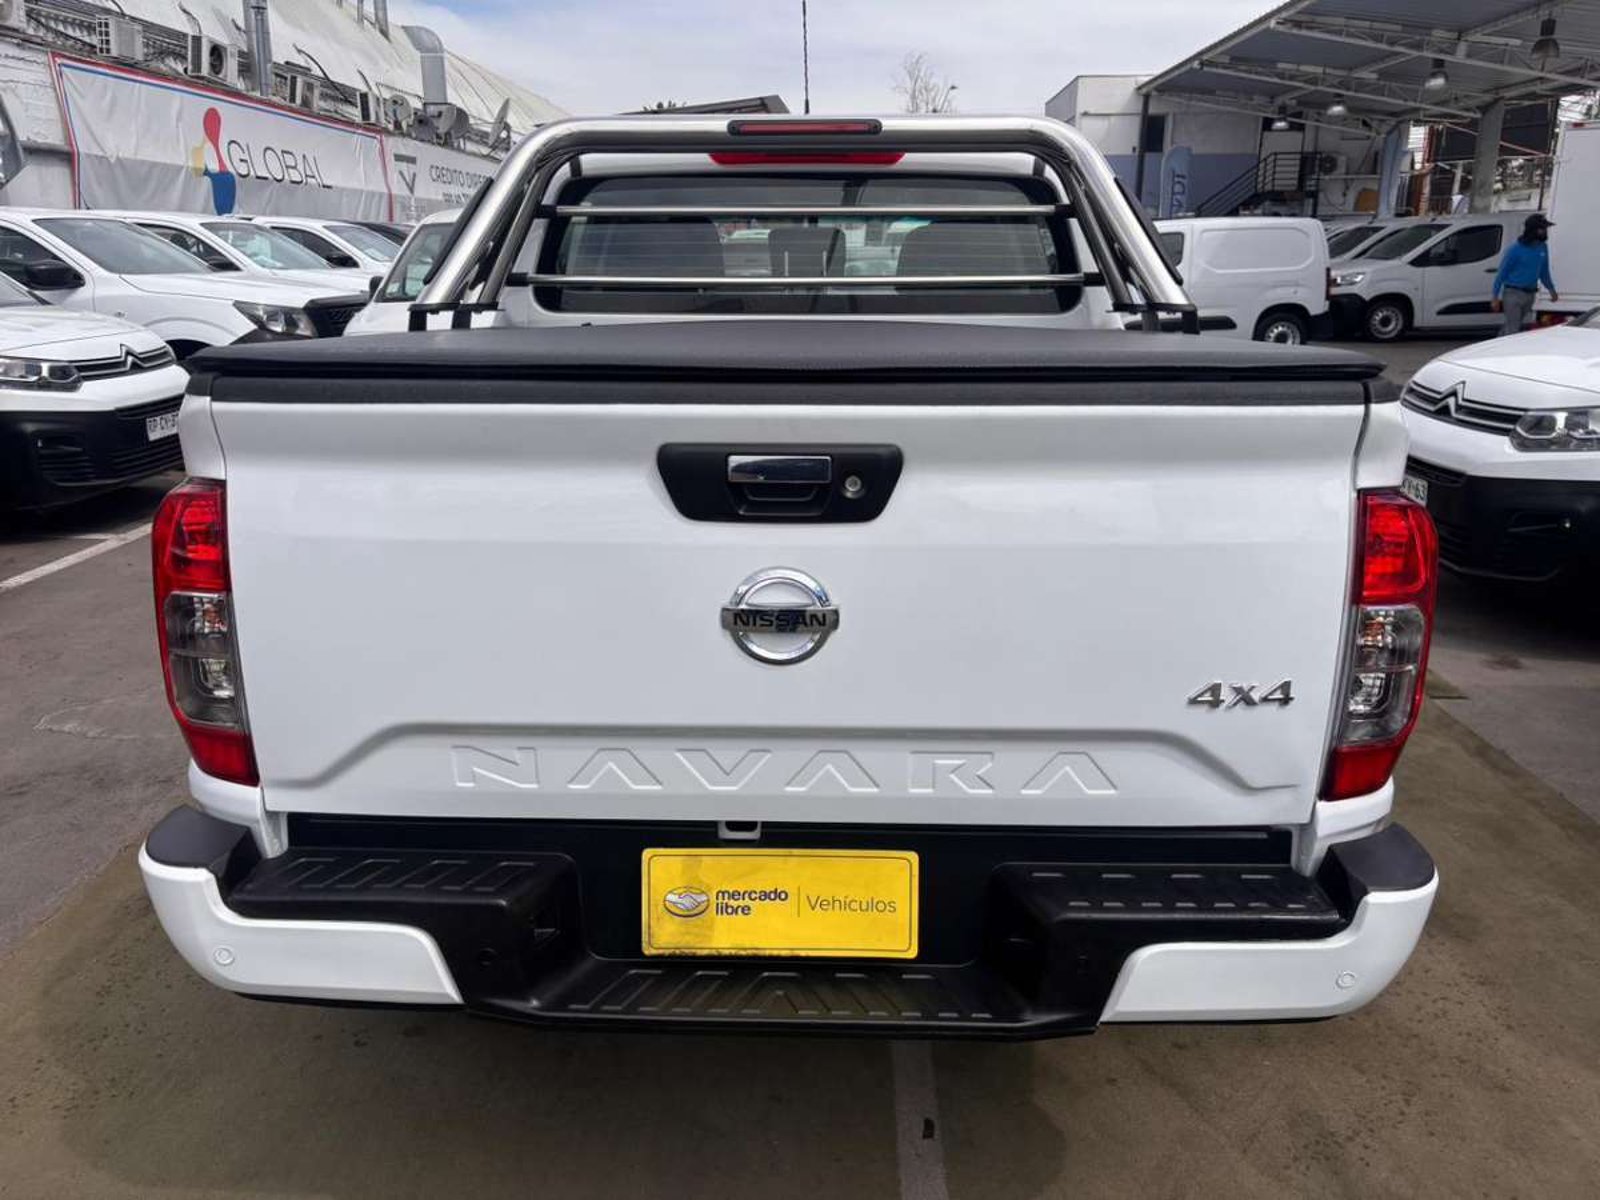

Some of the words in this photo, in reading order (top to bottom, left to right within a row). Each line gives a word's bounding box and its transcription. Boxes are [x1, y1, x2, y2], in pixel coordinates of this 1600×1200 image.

[227, 140, 333, 189] GLOBAL
[733, 612, 826, 628] NISSAN
[450, 744, 1119, 795] NAVARA
[715, 887, 789, 902] mercado
[715, 902, 752, 917] libre
[806, 894, 897, 914] Vehículos
